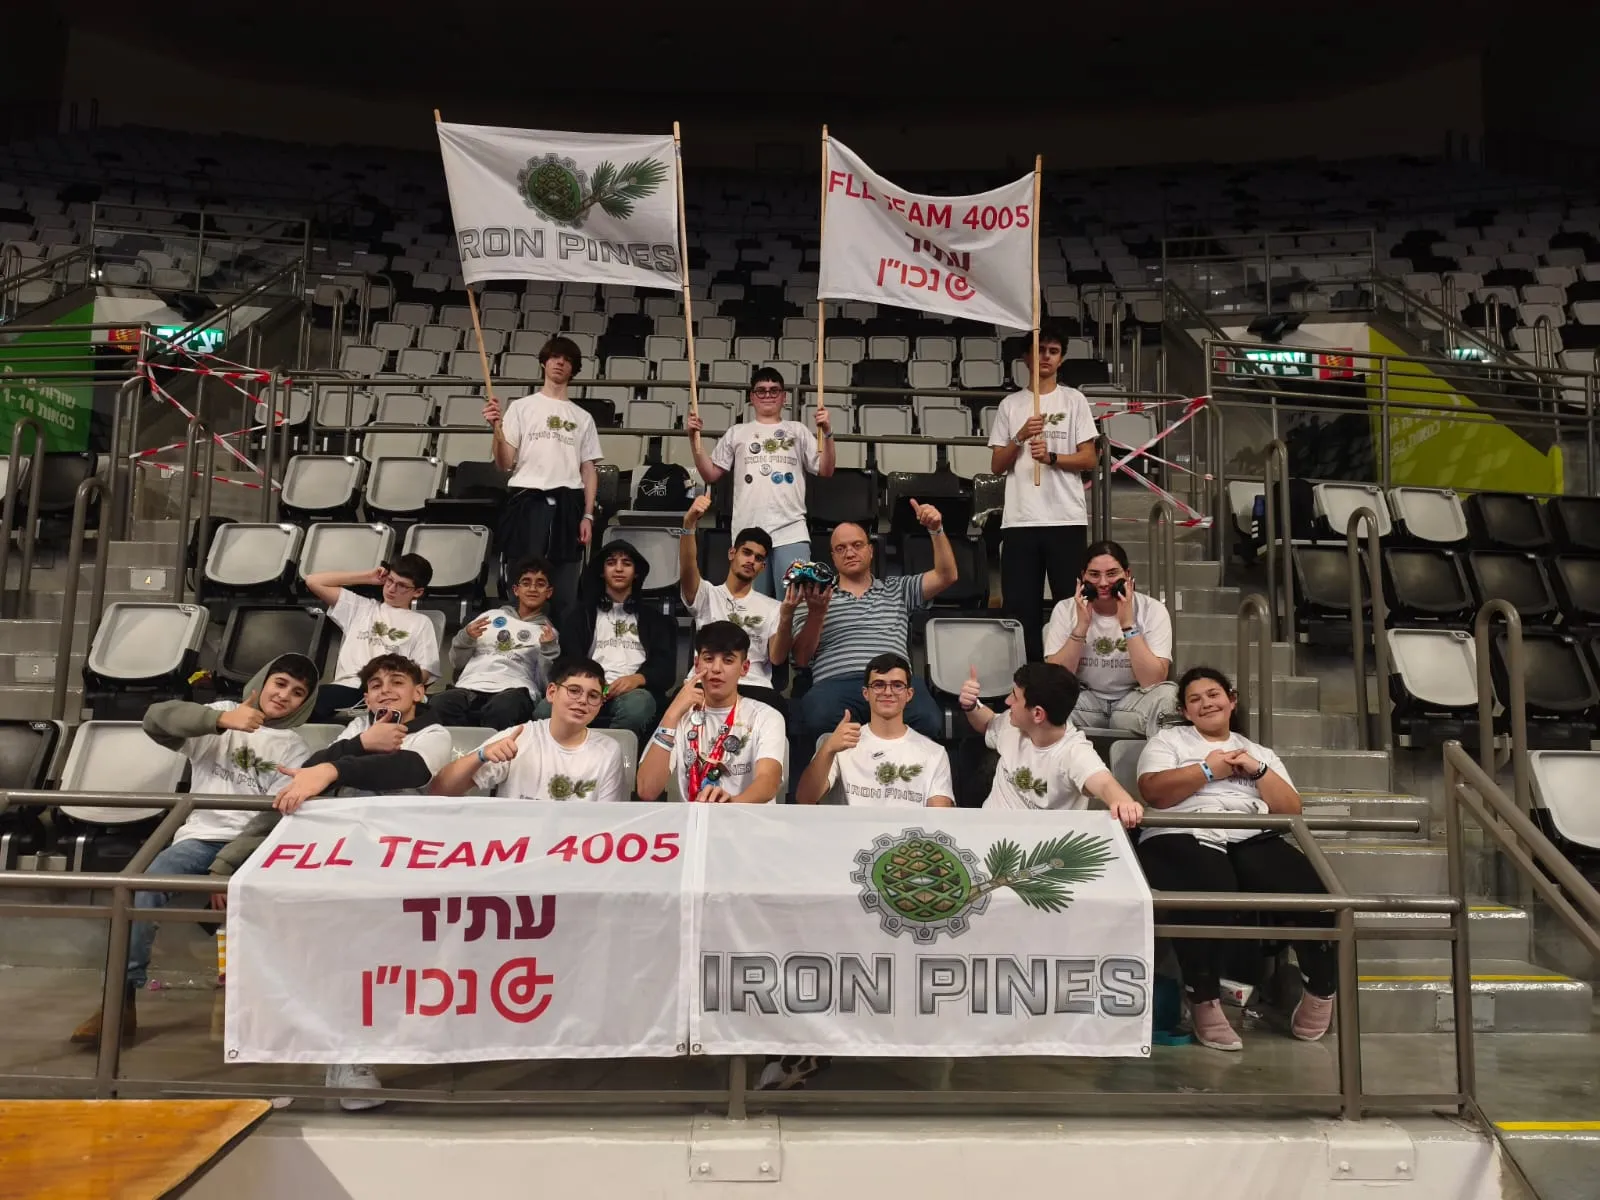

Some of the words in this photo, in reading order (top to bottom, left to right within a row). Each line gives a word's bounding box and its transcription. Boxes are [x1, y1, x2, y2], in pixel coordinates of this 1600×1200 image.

[962, 203, 1031, 231] 4005
[458, 227, 546, 264] RON
[557, 231, 679, 274] PINES
[261, 836, 354, 871] FLL
[378, 835, 531, 870] TEAM
[546, 831, 681, 865] 4005
[402, 893, 558, 943] עתיד
[700, 950, 897, 1018] IRON
[916, 953, 1151, 1018] PINES
